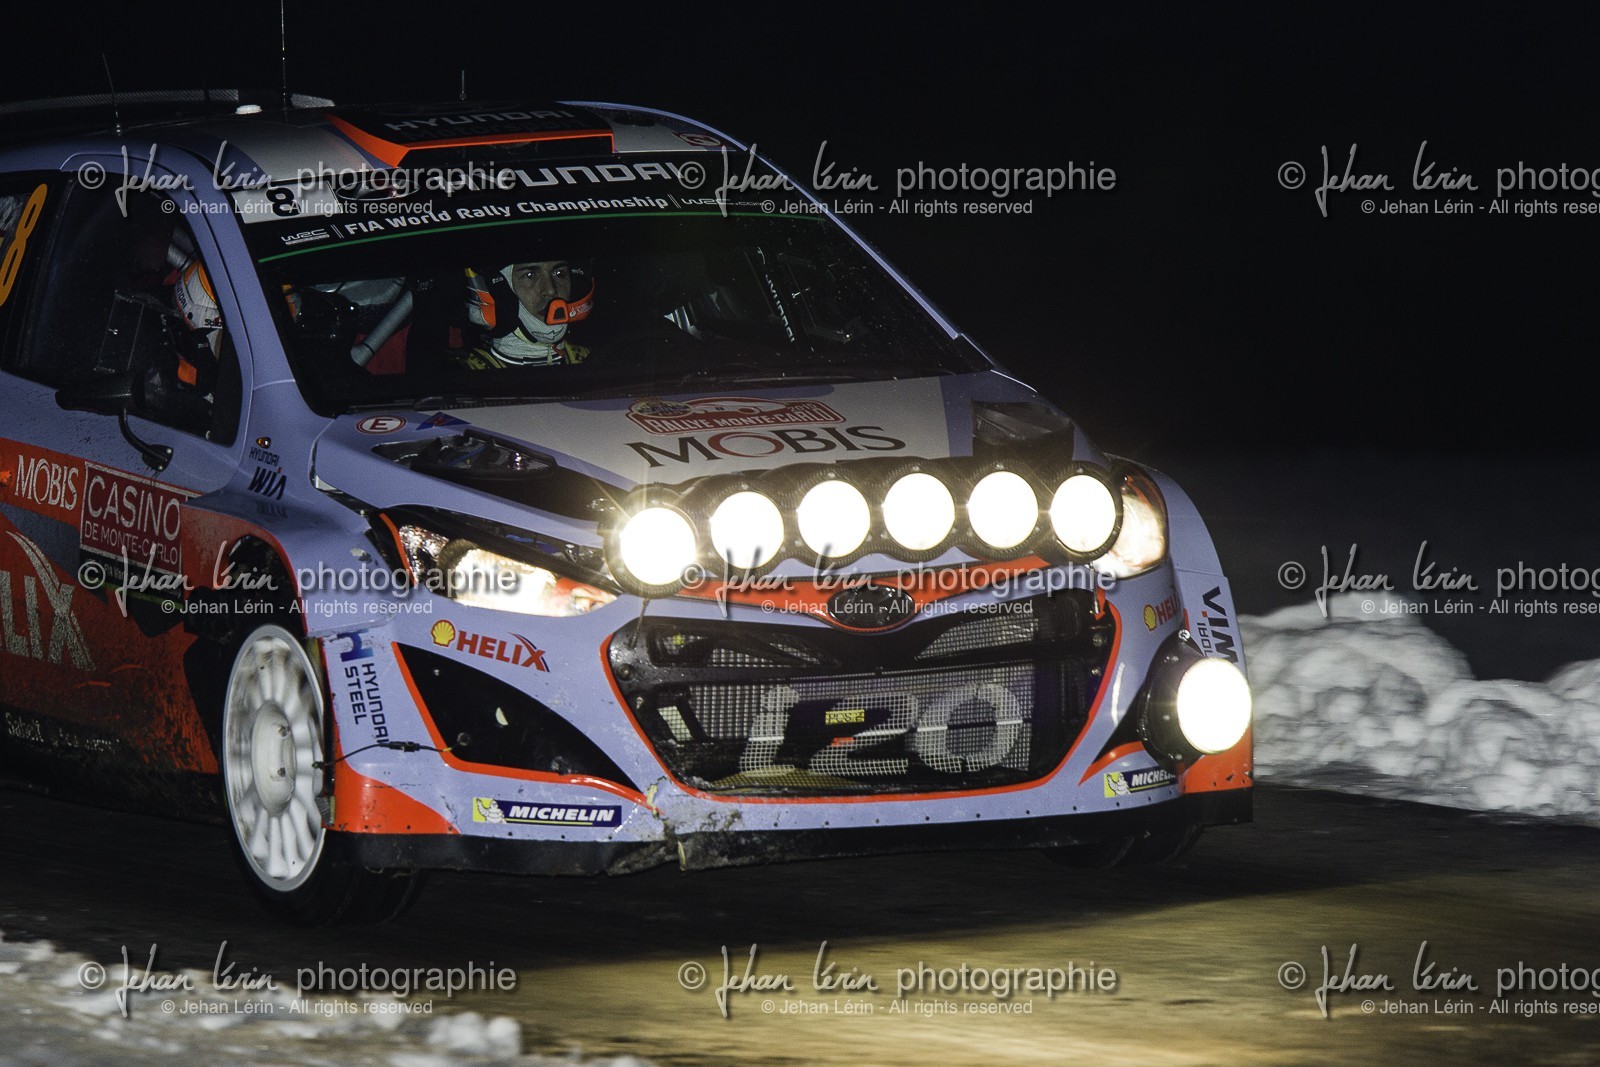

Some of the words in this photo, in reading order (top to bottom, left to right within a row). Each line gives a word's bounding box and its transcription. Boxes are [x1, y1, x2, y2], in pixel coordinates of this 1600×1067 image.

[384, 110, 577, 131] HYUNDAI
[265, 187, 296, 217] 8
[344, 220, 385, 235] FIA
[385, 210, 452, 228] World
[456, 202, 512, 219] Rally
[516, 194, 670, 213] Championship
[0, 183, 48, 308] 8
[369, 418, 393, 431] E
[643, 418, 715, 433] RALLYE
[250, 446, 280, 467] HYUNDAI
[624, 425, 907, 468] MOBIS
[14, 454, 79, 511] MOBIS
[87, 475, 181, 541] CASINO
[84, 520, 100, 541] DE
[0, 534, 96, 671] LIX
[456, 630, 550, 673] HELIX
[344, 666, 367, 725] STEEL
[361, 662, 390, 744] HYUNDAI
[508, 805, 615, 822] MICHELIN
